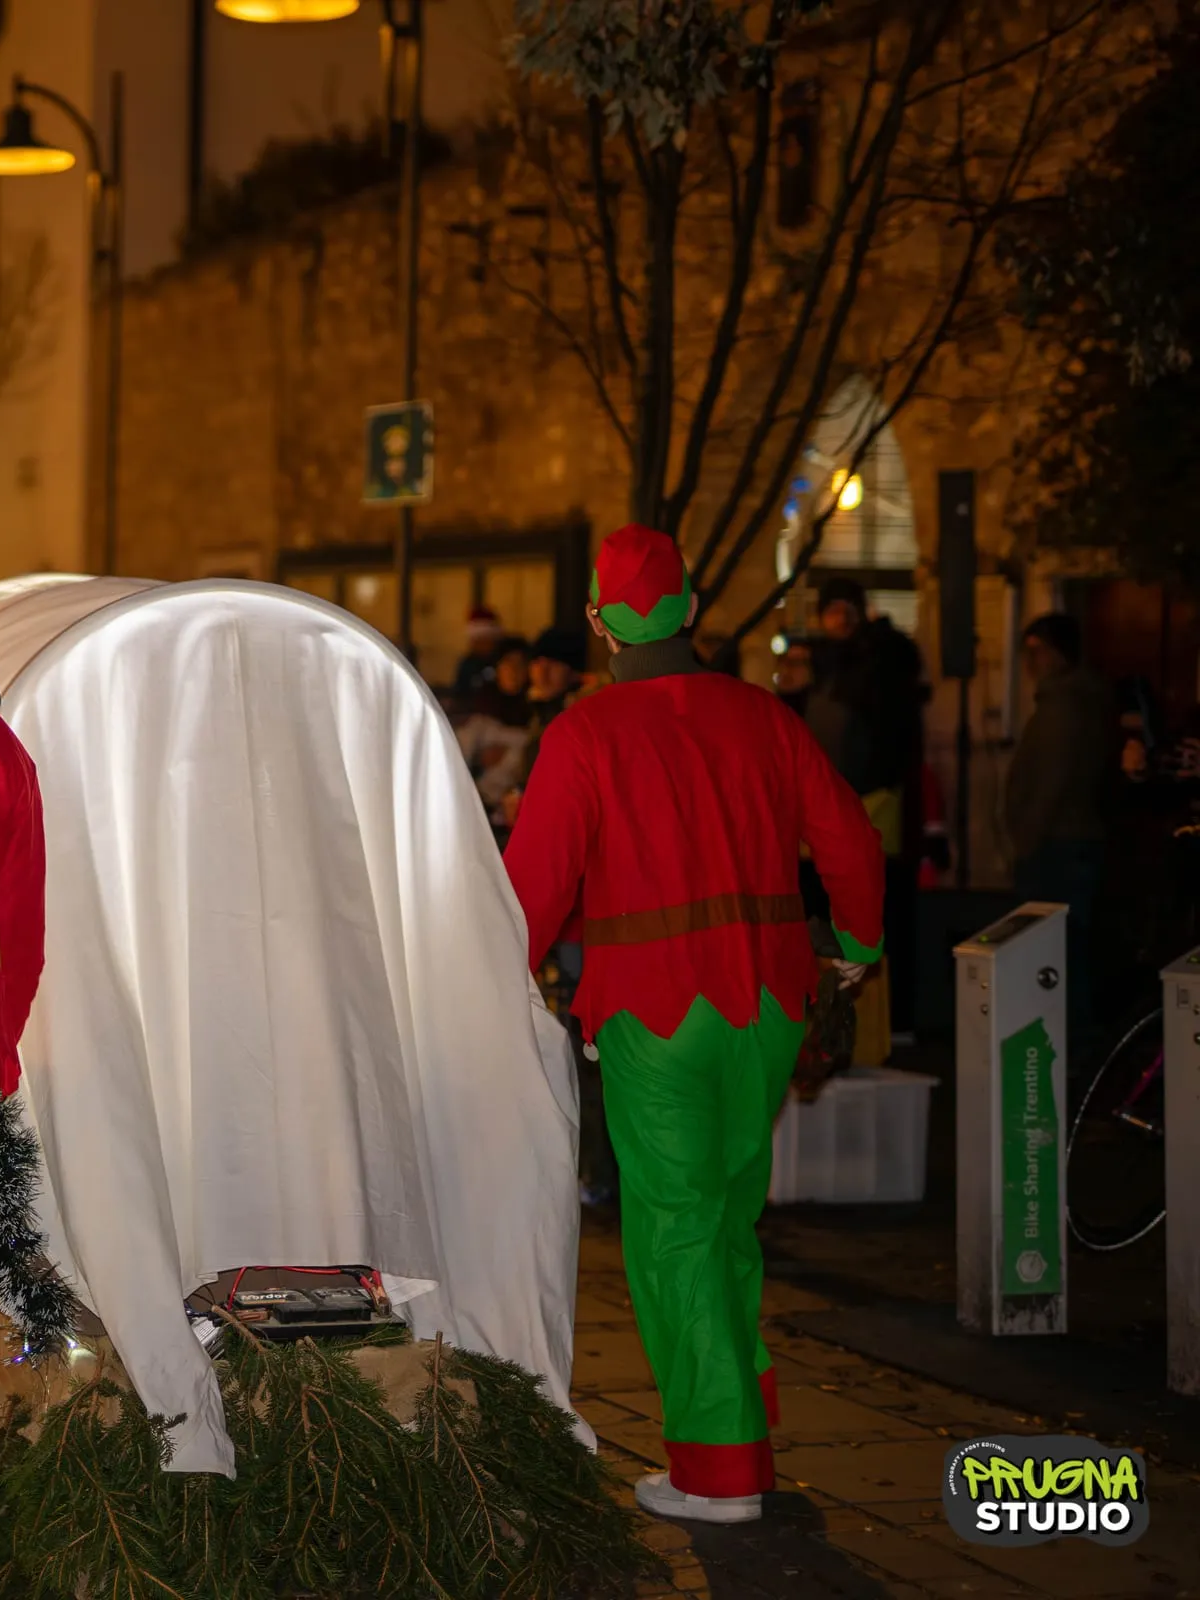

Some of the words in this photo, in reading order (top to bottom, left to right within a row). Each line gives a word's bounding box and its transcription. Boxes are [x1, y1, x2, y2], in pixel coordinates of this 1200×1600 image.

[1023, 1047, 1039, 1125] Trentino
[1023, 1127, 1042, 1196] Sharing
[1023, 1200, 1040, 1239] Bike
